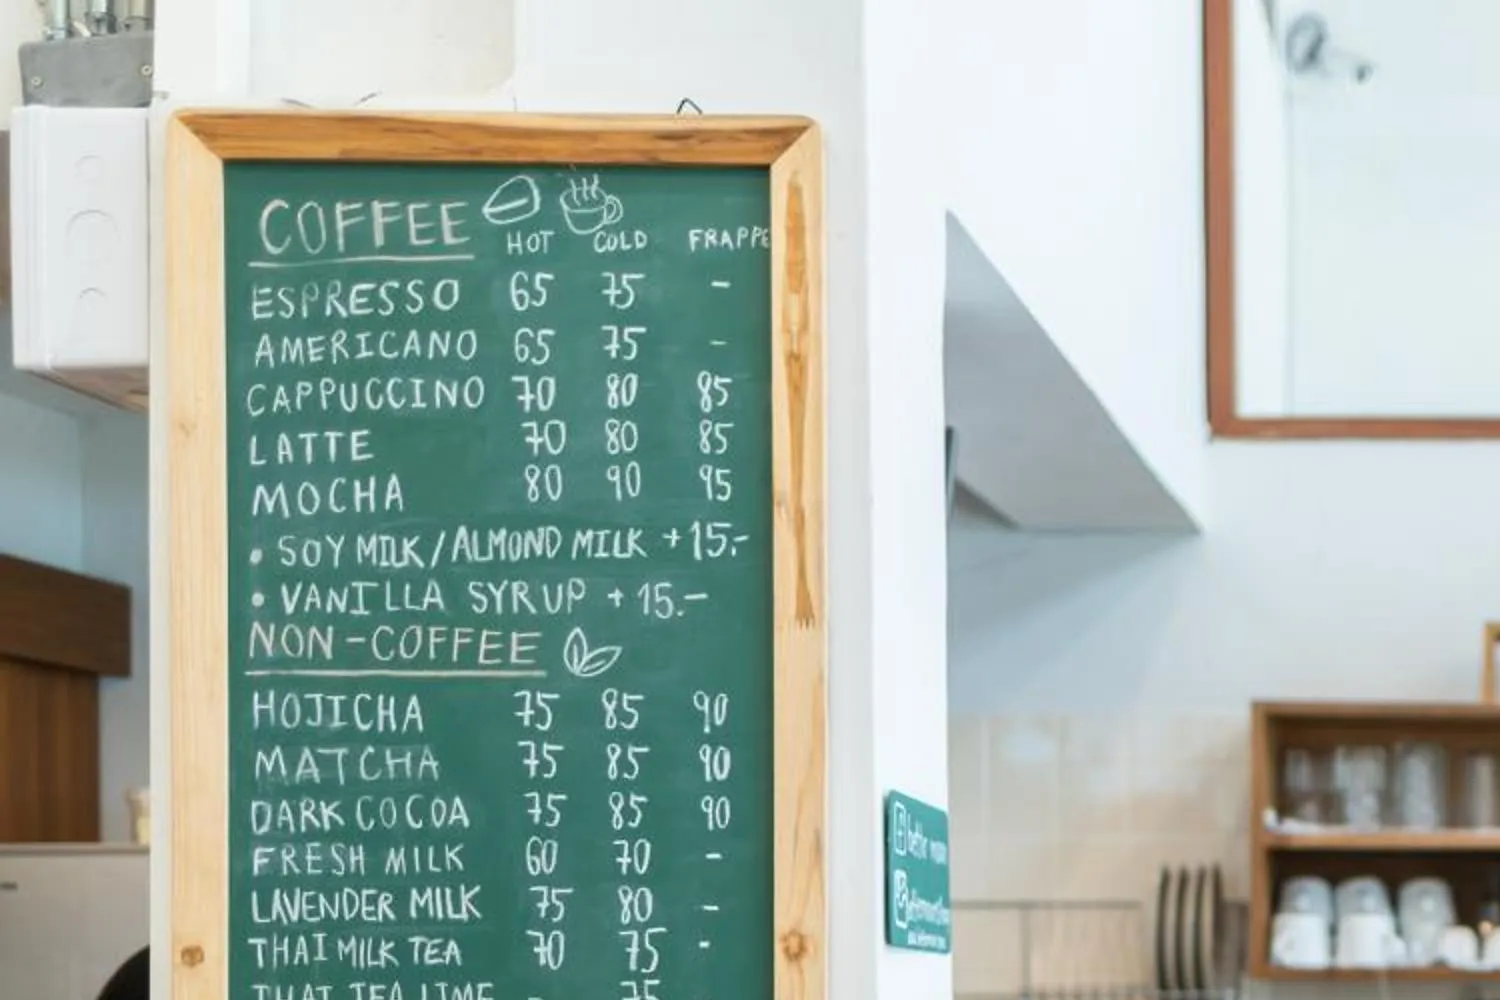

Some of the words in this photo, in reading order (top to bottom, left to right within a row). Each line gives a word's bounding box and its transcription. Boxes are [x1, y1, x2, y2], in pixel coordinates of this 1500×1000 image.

[259, 199, 471, 254] COFFEE
[507, 231, 554, 254] HOT
[594, 231, 647, 252] COLD
[689, 227, 770, 251] FRAPPE
[252, 279, 459, 319] ESPRESSO
[510, 273, 555, 310] 65
[602, 273, 644, 307] 75
[255, 330, 478, 368] AMERICANO
[514, 330, 555, 364] 65
[602, 326, 646, 360] 75
[248, 377, 485, 416] CAPPUCCINO
[512, 376, 555, 411] 70
[606, 374, 638, 406] 80
[698, 371, 732, 412] 85
[250, 430, 374, 465] LATTE
[522, 421, 566, 456] 70
[606, 420, 638, 453] 80
[699, 420, 733, 455] 85
[253, 474, 403, 517] MOCHA
[525, 465, 562, 501] 80
[607, 463, 641, 499] 90
[700, 465, 732, 501] 95
[280, 537, 345, 566] SOY
[573, 529, 646, 557] MILK
[281, 581, 445, 615] VANILLA
[469, 579, 585, 614] SYRUP
[249, 626, 542, 666] NON-COFFEE
[253, 691, 423, 731] HOJICHA
[514, 691, 560, 729] 75
[603, 689, 644, 729] 85
[694, 691, 728, 733] 90
[255, 746, 438, 785] MATCHA
[519, 742, 564, 778] 75
[607, 745, 649, 780] 85
[699, 748, 731, 780] 90
[252, 801, 344, 834] DARK
[356, 797, 470, 830] COCOA
[526, 794, 567, 828] 75
[609, 793, 649, 828] 85
[702, 796, 731, 830] 90
[253, 846, 365, 877] FRESH
[386, 845, 464, 874] MILK
[527, 838, 557, 874] 60
[614, 839, 651, 874] 70
[410, 886, 482, 921] MILK
[531, 887, 574, 922] 75
[619, 887, 652, 923] 80
[248, 937, 328, 968] THAI
[338, 938, 399, 968] MILK
[410, 937, 461, 967] TEA
[527, 930, 564, 969] 70
[620, 929, 667, 973] 75
